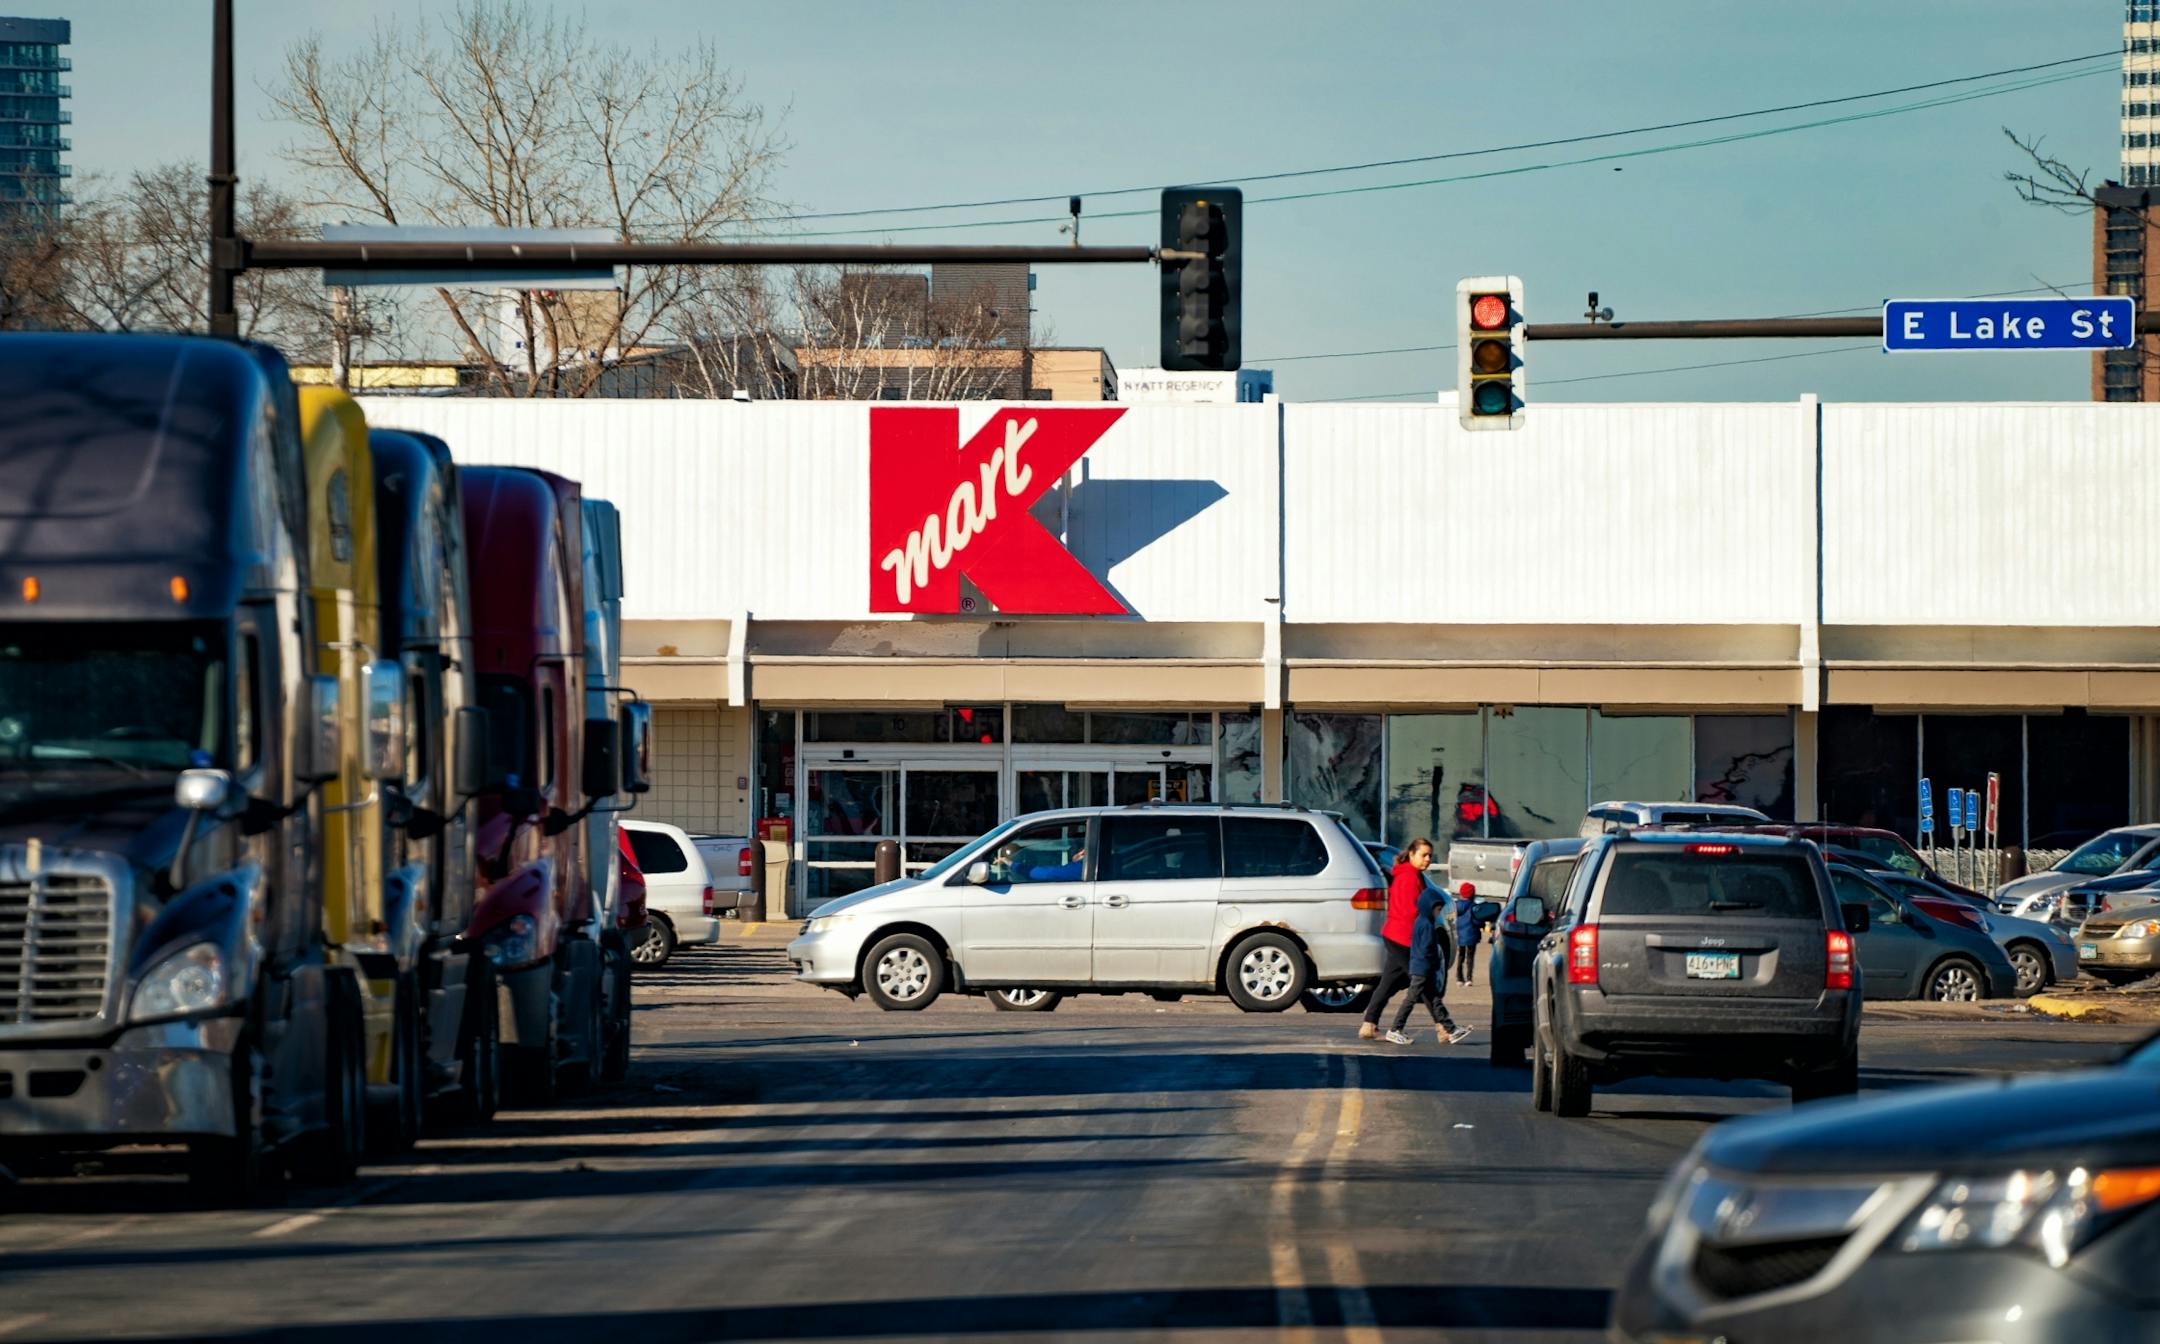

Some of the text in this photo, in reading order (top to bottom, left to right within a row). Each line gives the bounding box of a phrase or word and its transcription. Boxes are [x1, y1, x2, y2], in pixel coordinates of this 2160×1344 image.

[1904, 310, 2114, 339] E Lake St
[1166, 381, 1223, 391] REGENCY
[1701, 936, 1725, 947] Jeep
